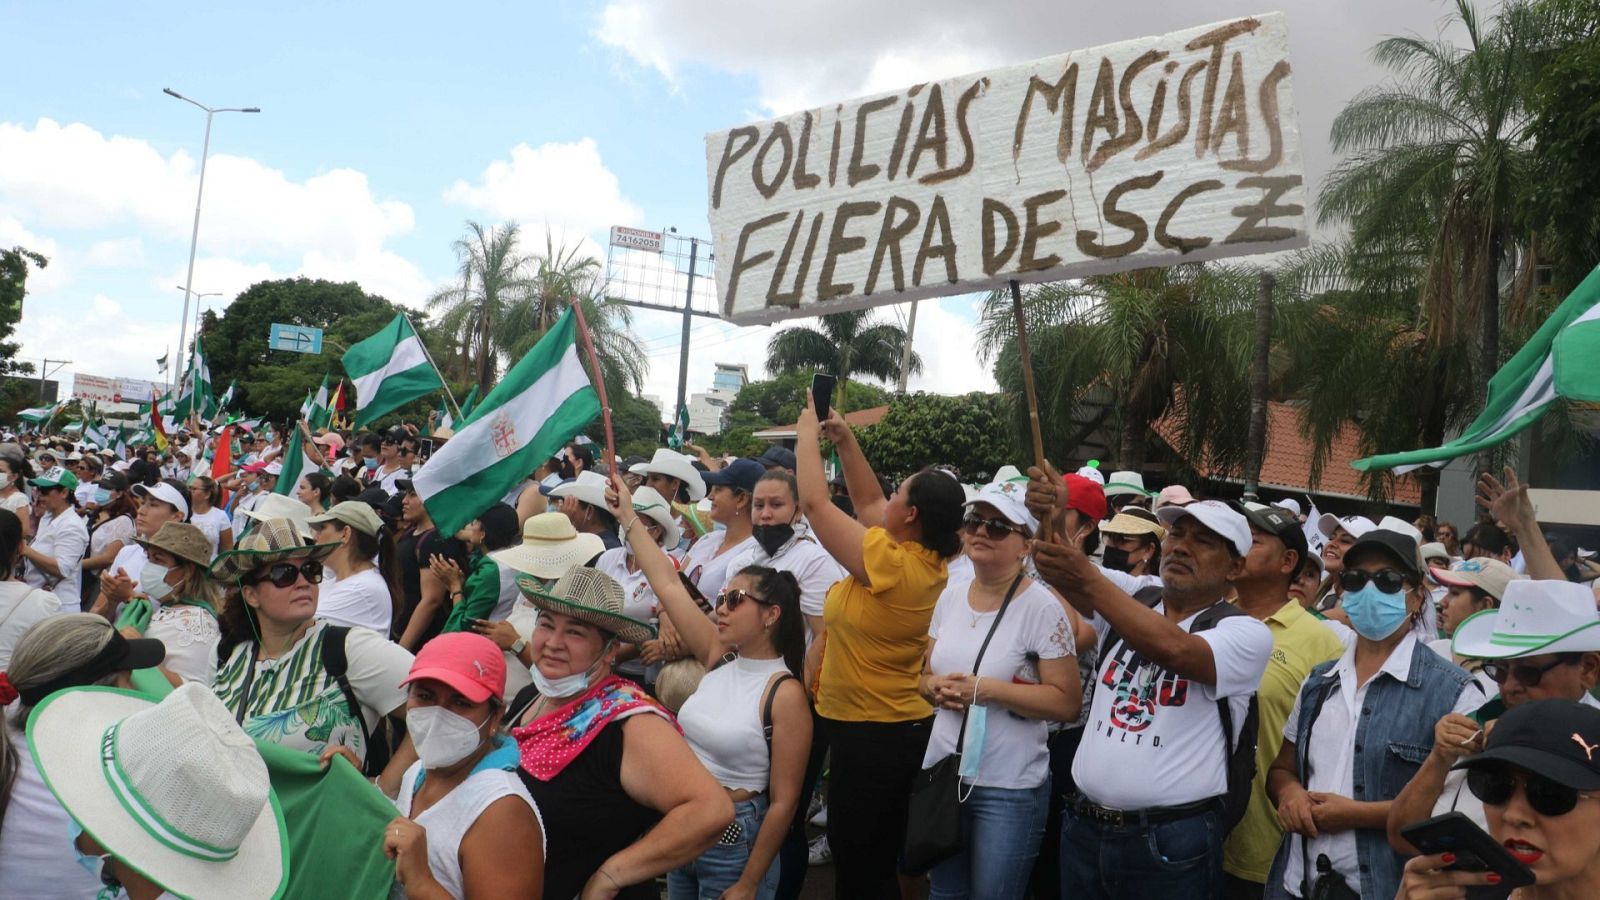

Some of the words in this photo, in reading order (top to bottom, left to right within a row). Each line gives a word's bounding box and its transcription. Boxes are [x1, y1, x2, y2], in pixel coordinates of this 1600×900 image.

[616, 235, 660, 248] 74162058
[724, 195, 957, 316] FUERA
[981, 189, 1066, 276] DE
[1076, 170, 1303, 257] SCZ
